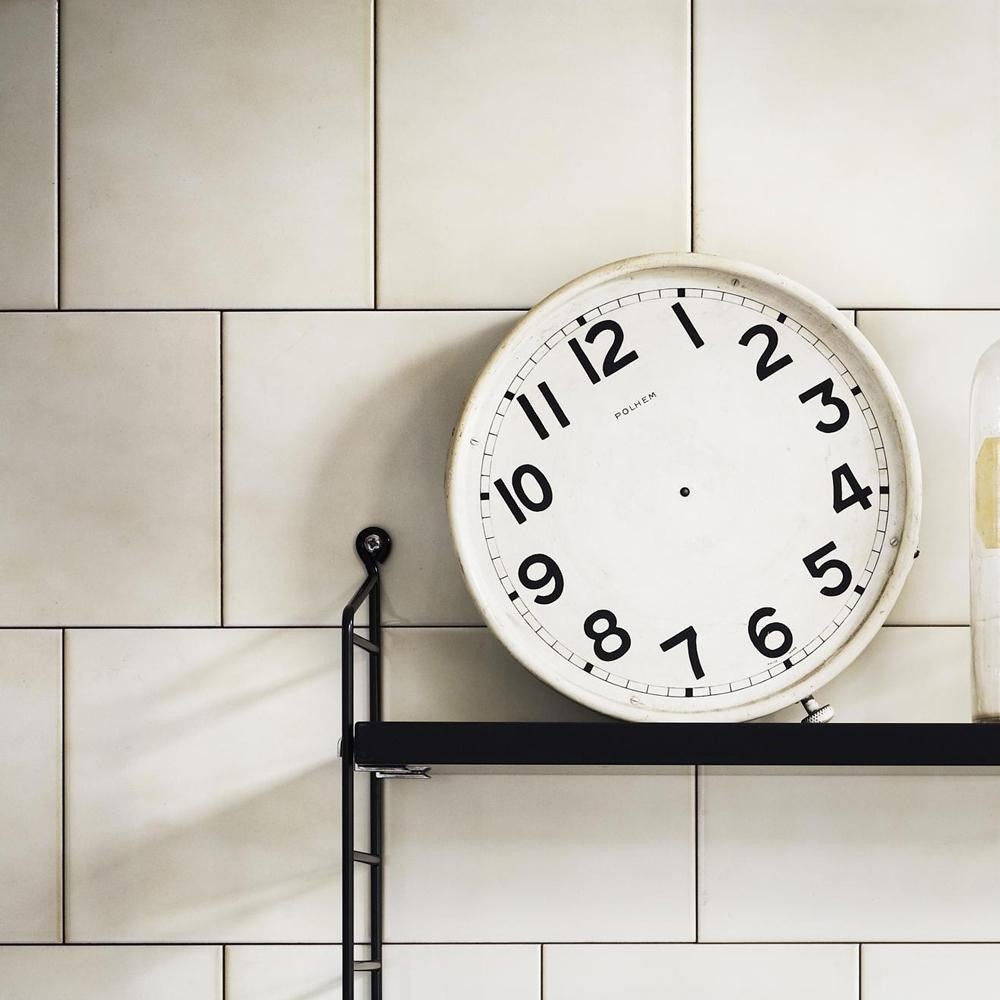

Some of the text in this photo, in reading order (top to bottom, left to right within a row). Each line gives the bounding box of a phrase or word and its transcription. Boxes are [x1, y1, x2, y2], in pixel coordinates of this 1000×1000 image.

[567, 319, 639, 385] 12
[671, 301, 705, 349] 1
[738, 323, 794, 382] 2
[516, 381, 571, 441] 11
[614, 391, 657, 420] POLHEM
[798, 377, 850, 434] 3
[493, 463, 553, 525] 10
[831, 462, 873, 514] 4
[517, 553, 565, 605] 9
[802, 540, 853, 597] 5
[583, 609, 632, 662] 8
[659, 625, 706, 681] 7
[747, 606, 794, 659] 6
